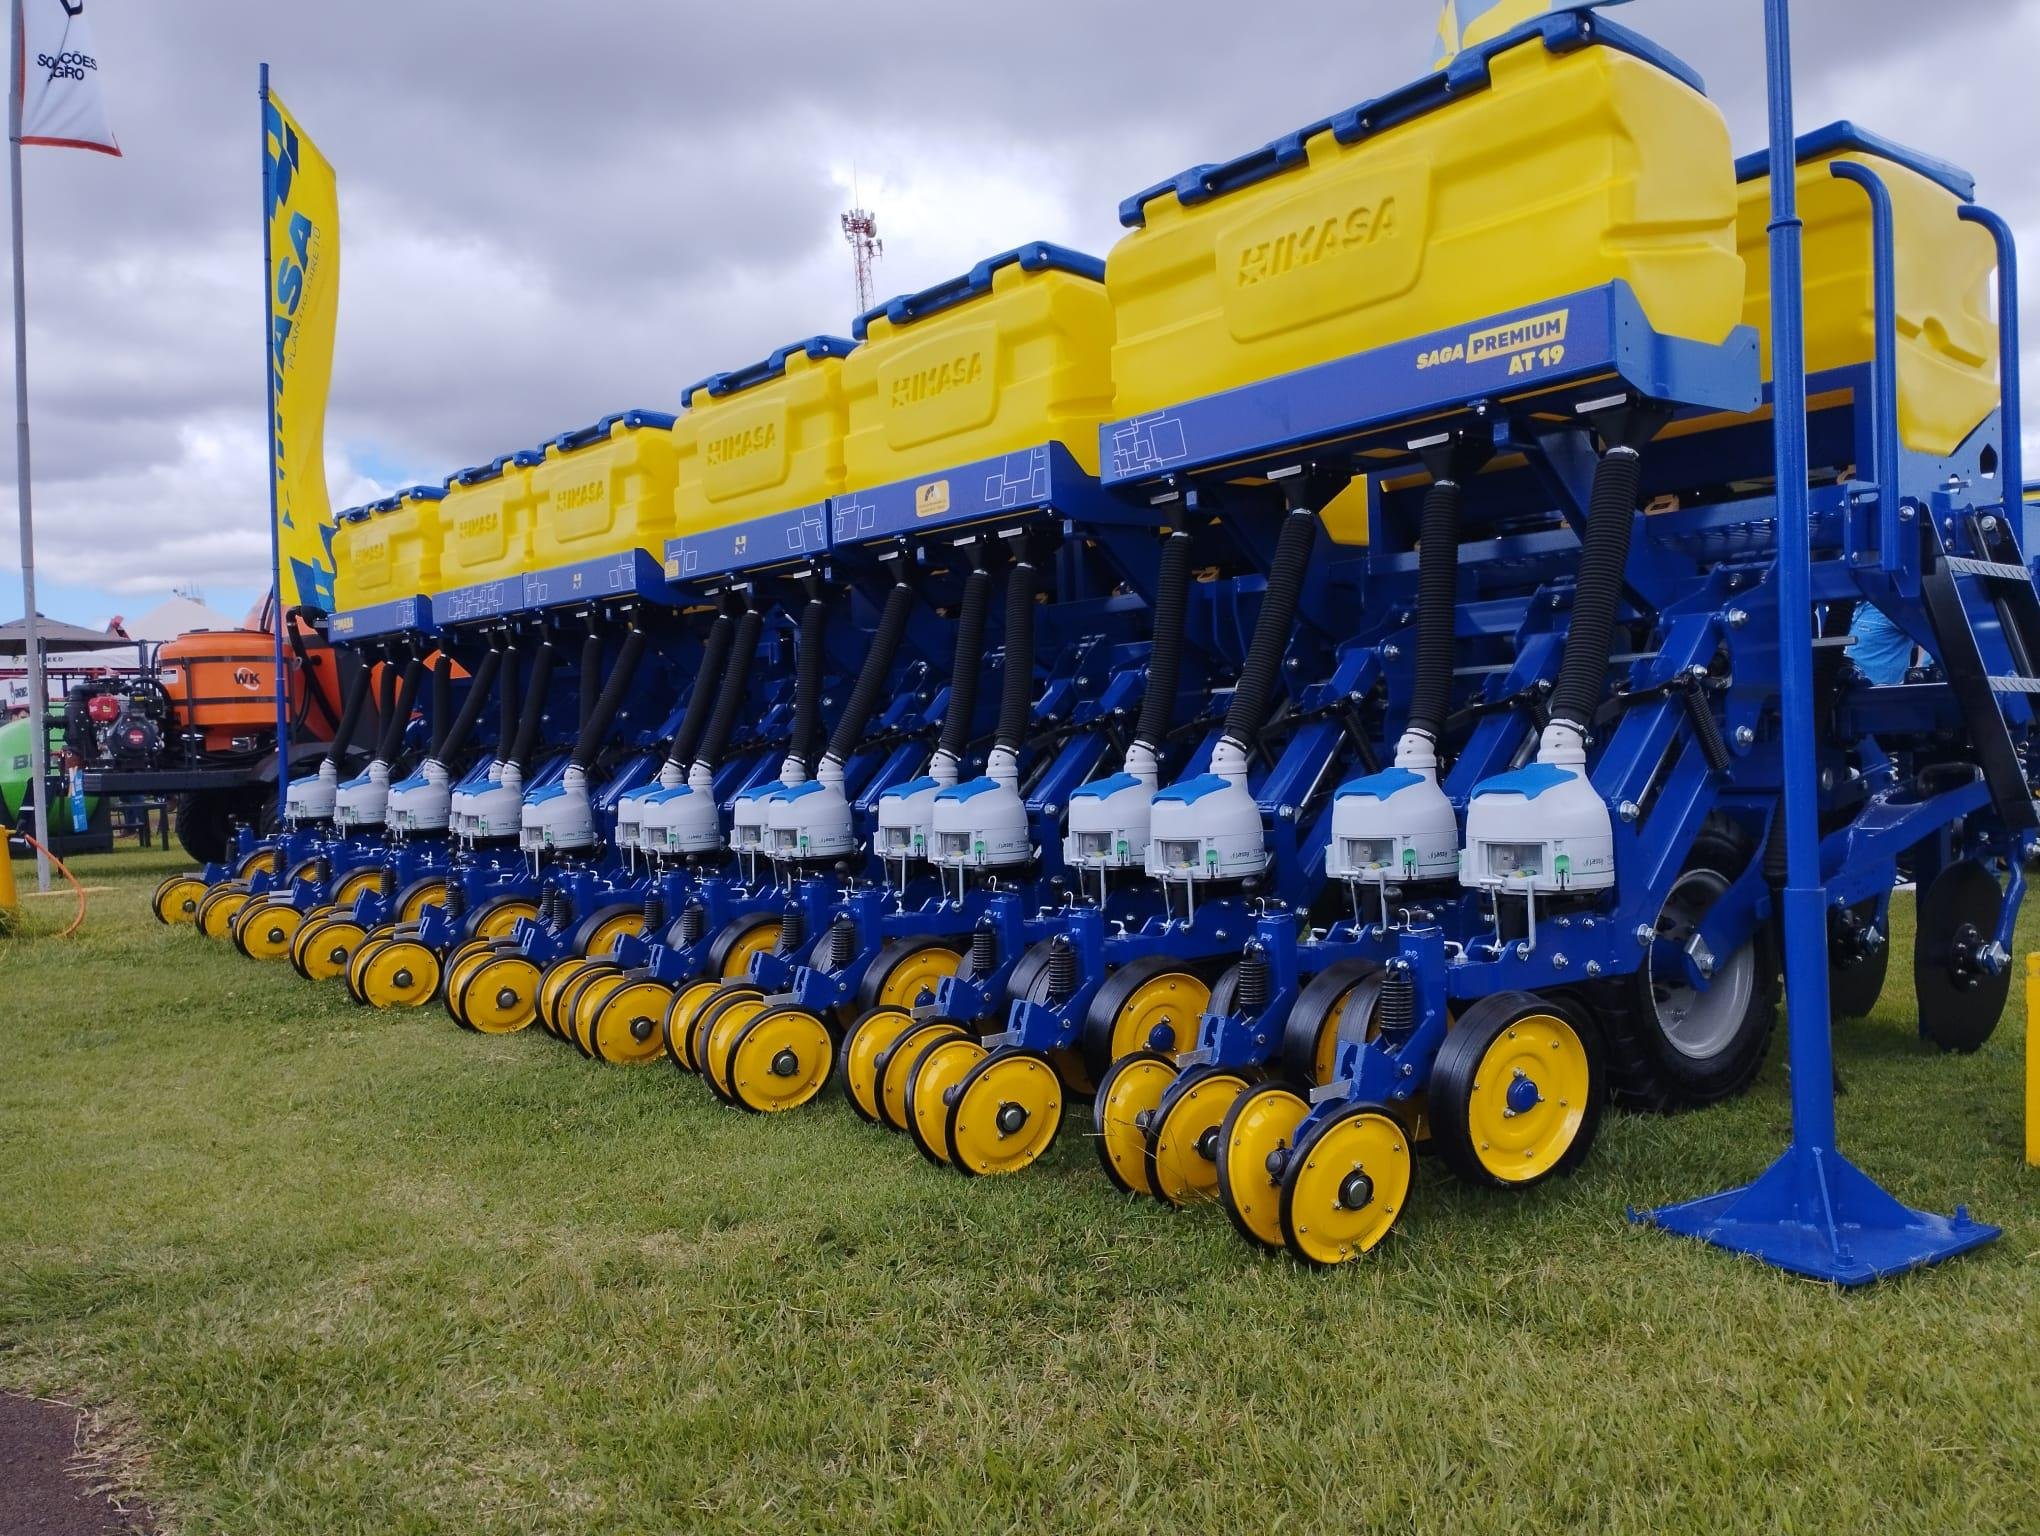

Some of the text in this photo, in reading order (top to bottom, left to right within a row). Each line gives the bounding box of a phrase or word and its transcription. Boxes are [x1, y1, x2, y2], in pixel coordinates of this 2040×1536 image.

[37, 50, 97, 71] SOÇÕES
[47, 66, 84, 82] GRO
[1416, 318, 1562, 370] SAGA PREMIUM
[1508, 344, 1565, 376] AT 19
[233, 672, 261, 685] WK
